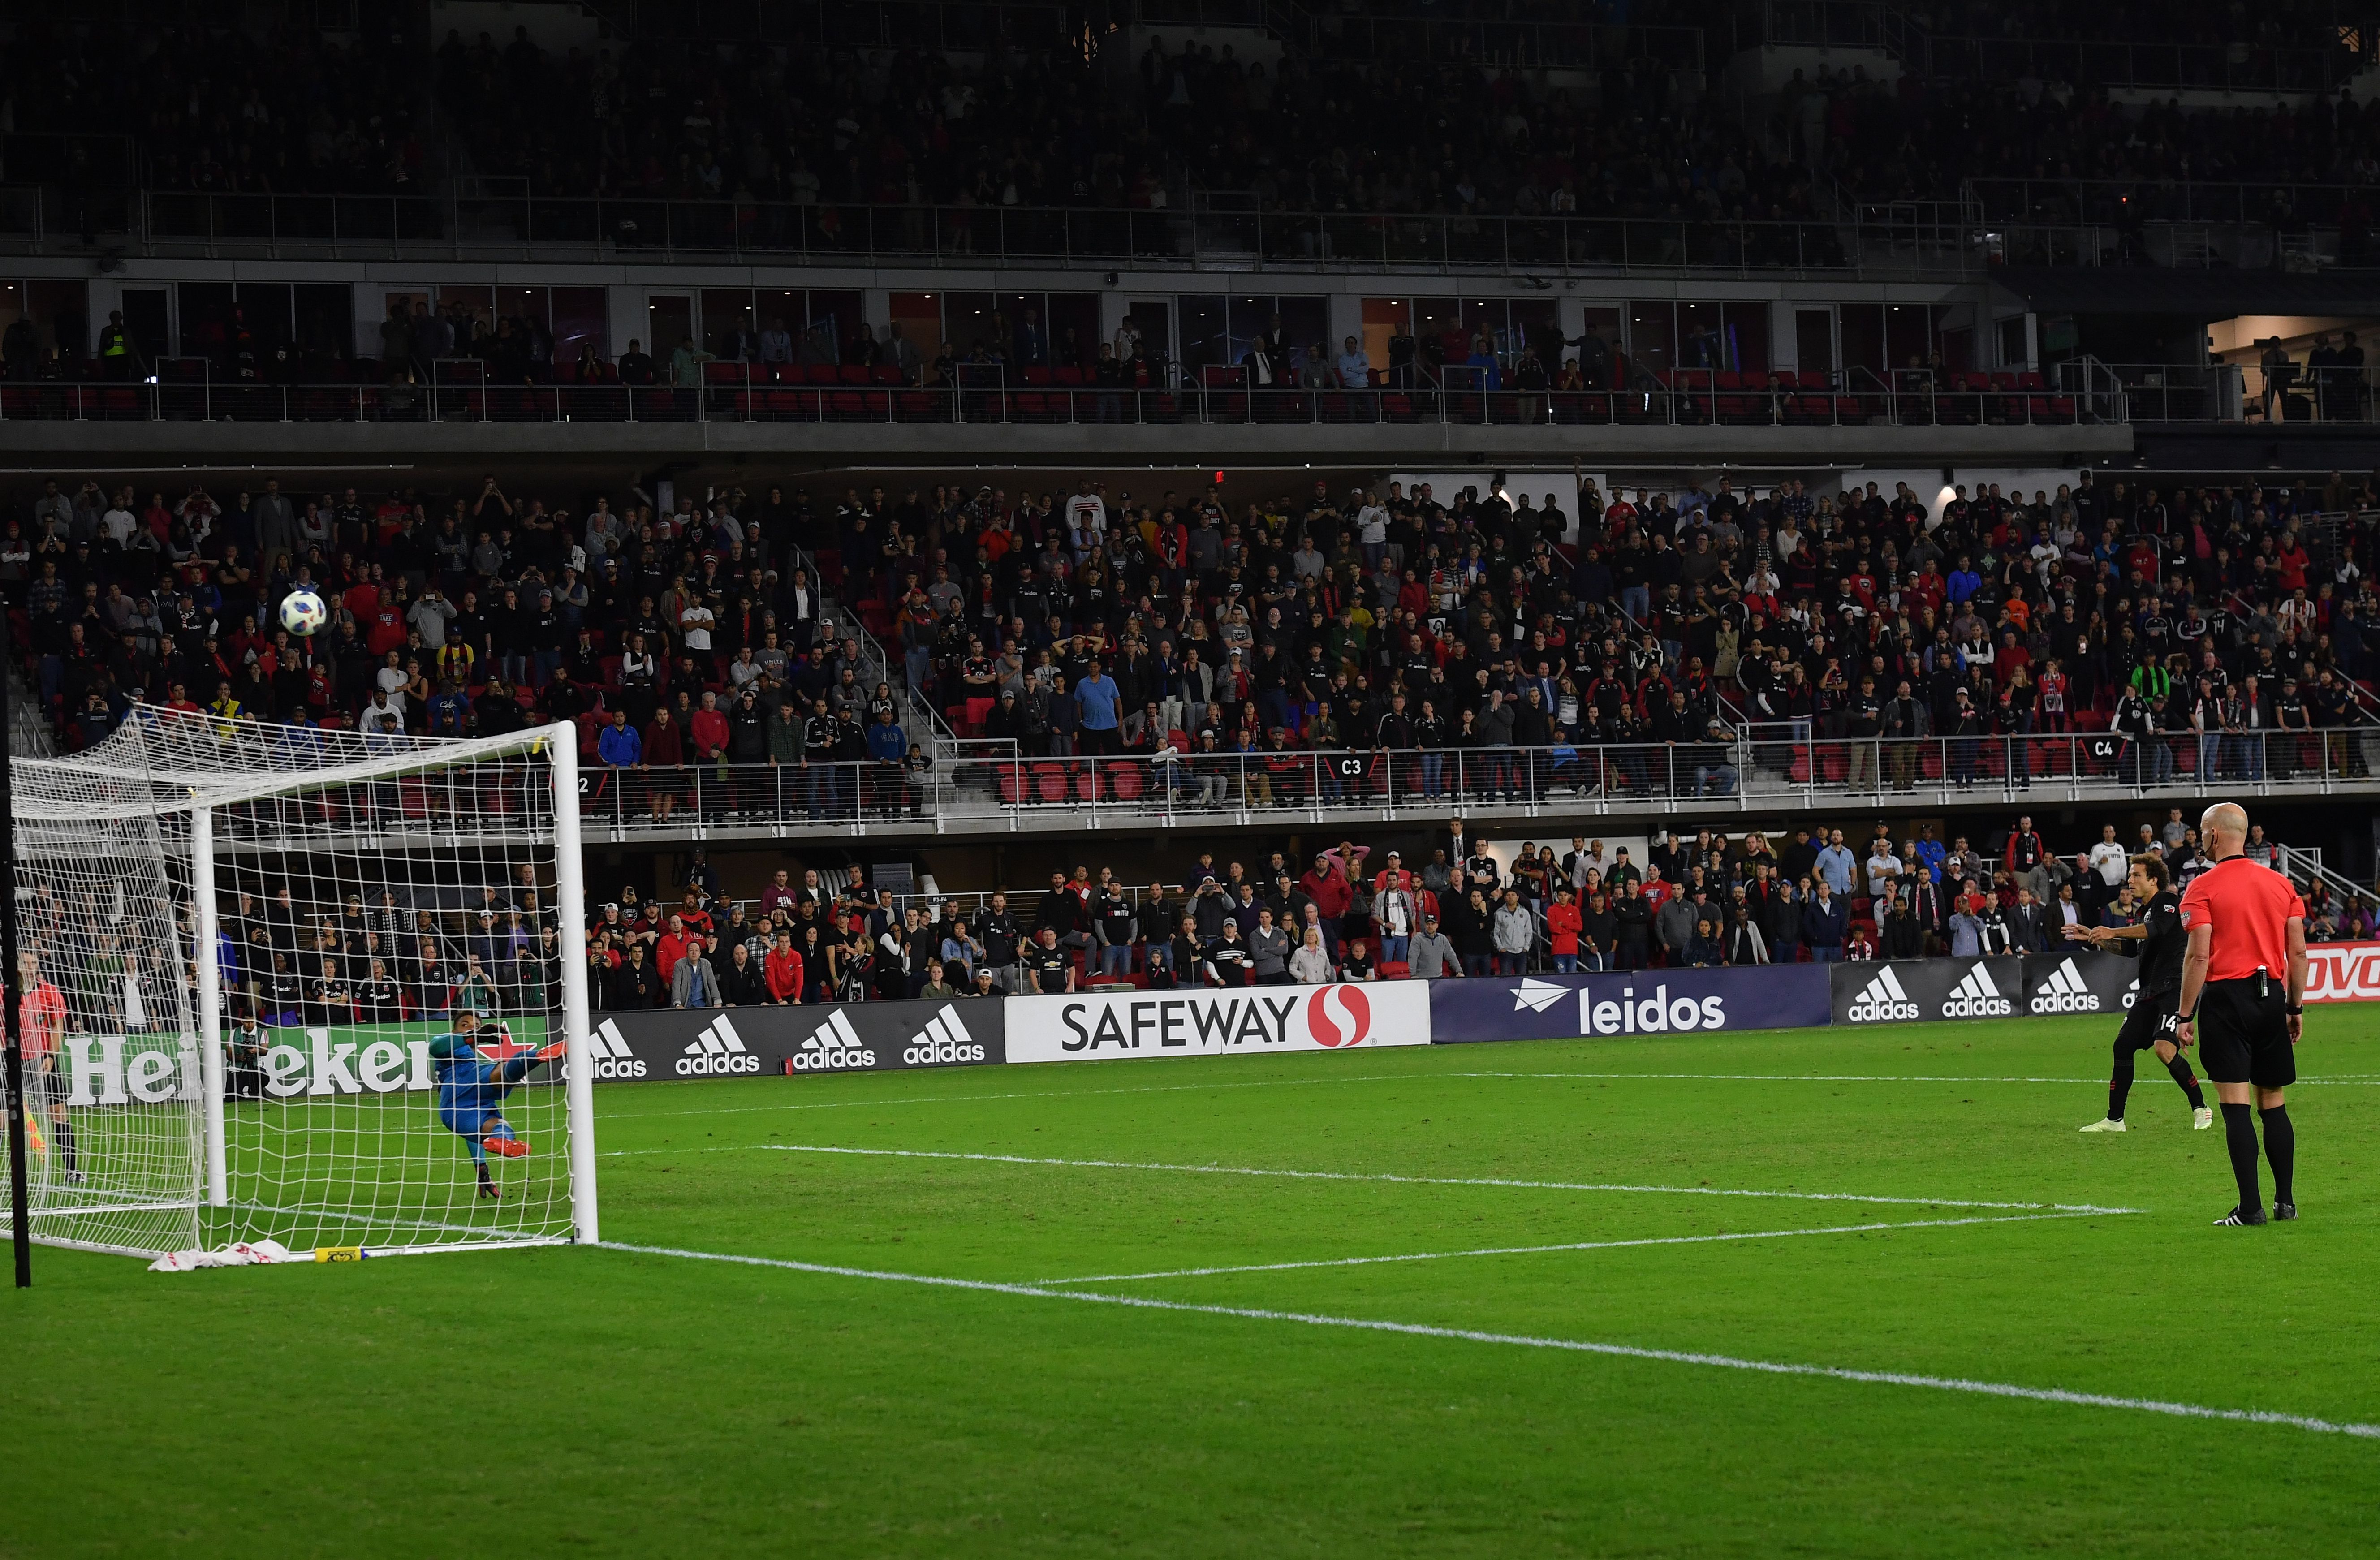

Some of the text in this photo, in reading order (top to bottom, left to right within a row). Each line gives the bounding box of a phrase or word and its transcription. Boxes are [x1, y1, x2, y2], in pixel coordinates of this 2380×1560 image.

[2095, 741, 2113, 756] C4
[1342, 759, 1362, 775] C3
[1645, 890, 1659, 898] TAKE
[688, 930, 704, 940] AIG
[1579, 984, 1725, 1034] leidos
[1849, 998, 1919, 1022] adidas
[1942, 995, 2011, 1017] adidas
[2031, 991, 2100, 1013] adidas
[1062, 996, 1298, 1051] SAFEWAY
[2160, 1014, 2177, 1032] 14
[675, 1051, 760, 1075] adidas
[793, 1046, 876, 1070] adidas
[904, 1040, 985, 1065] adidas
[65, 1028, 433, 1105] Heieke
